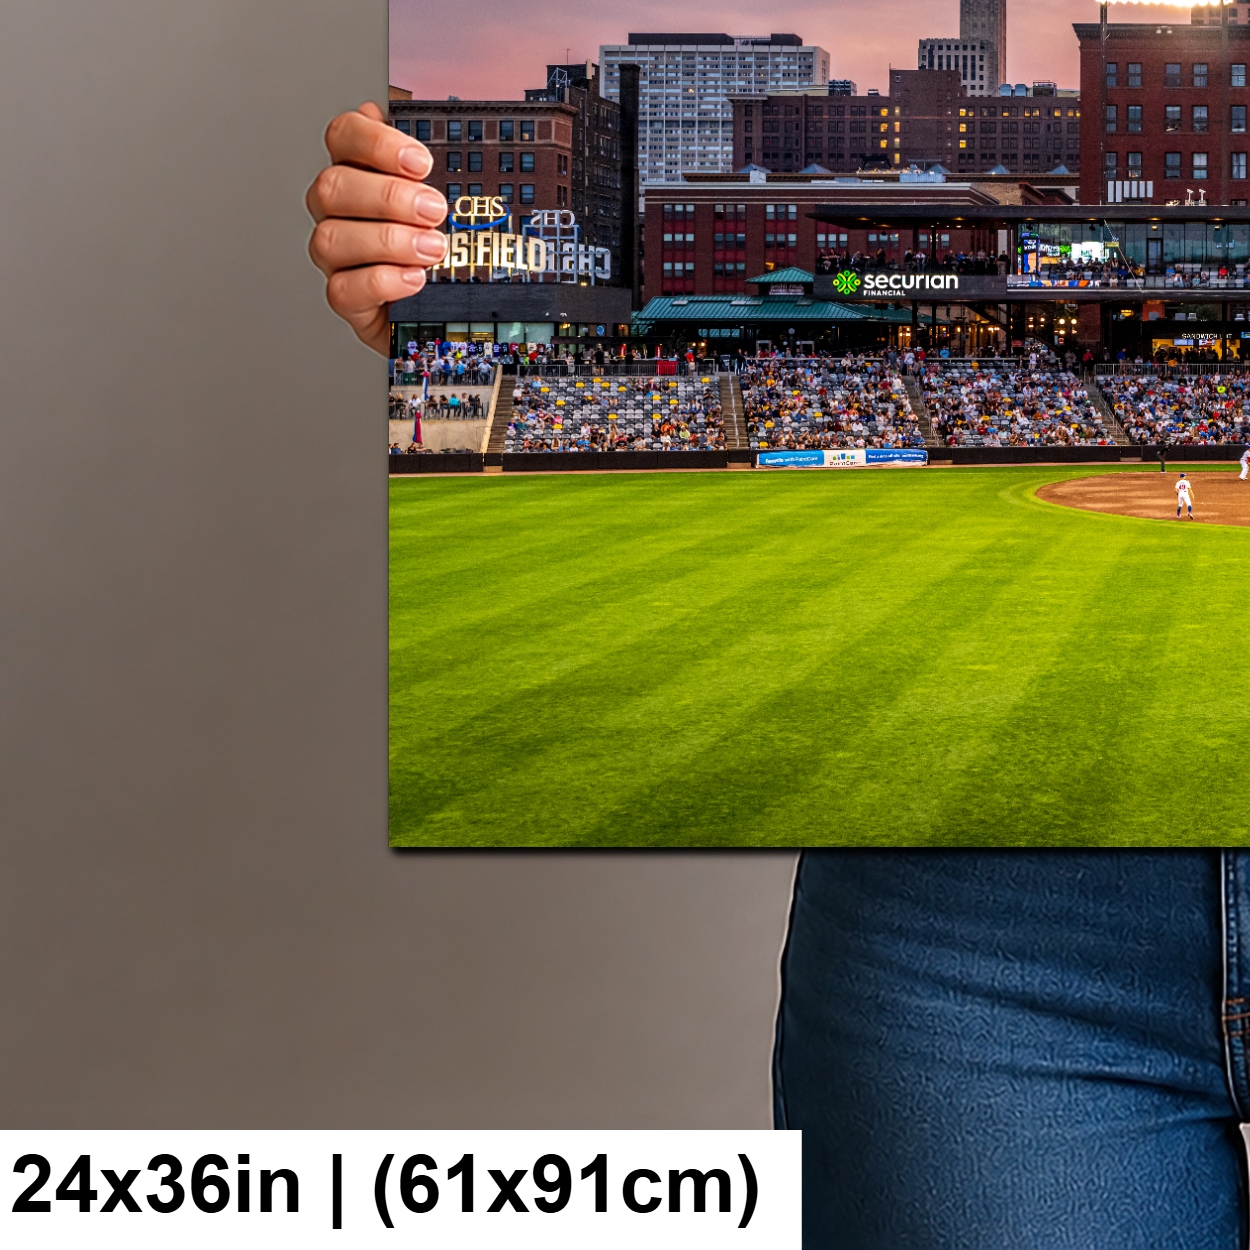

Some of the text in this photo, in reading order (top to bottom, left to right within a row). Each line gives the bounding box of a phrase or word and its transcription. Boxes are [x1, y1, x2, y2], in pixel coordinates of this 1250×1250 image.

[455, 196, 504, 217] CHS
[477, 231, 547, 273] FIELD
[863, 274, 959, 290] securian
